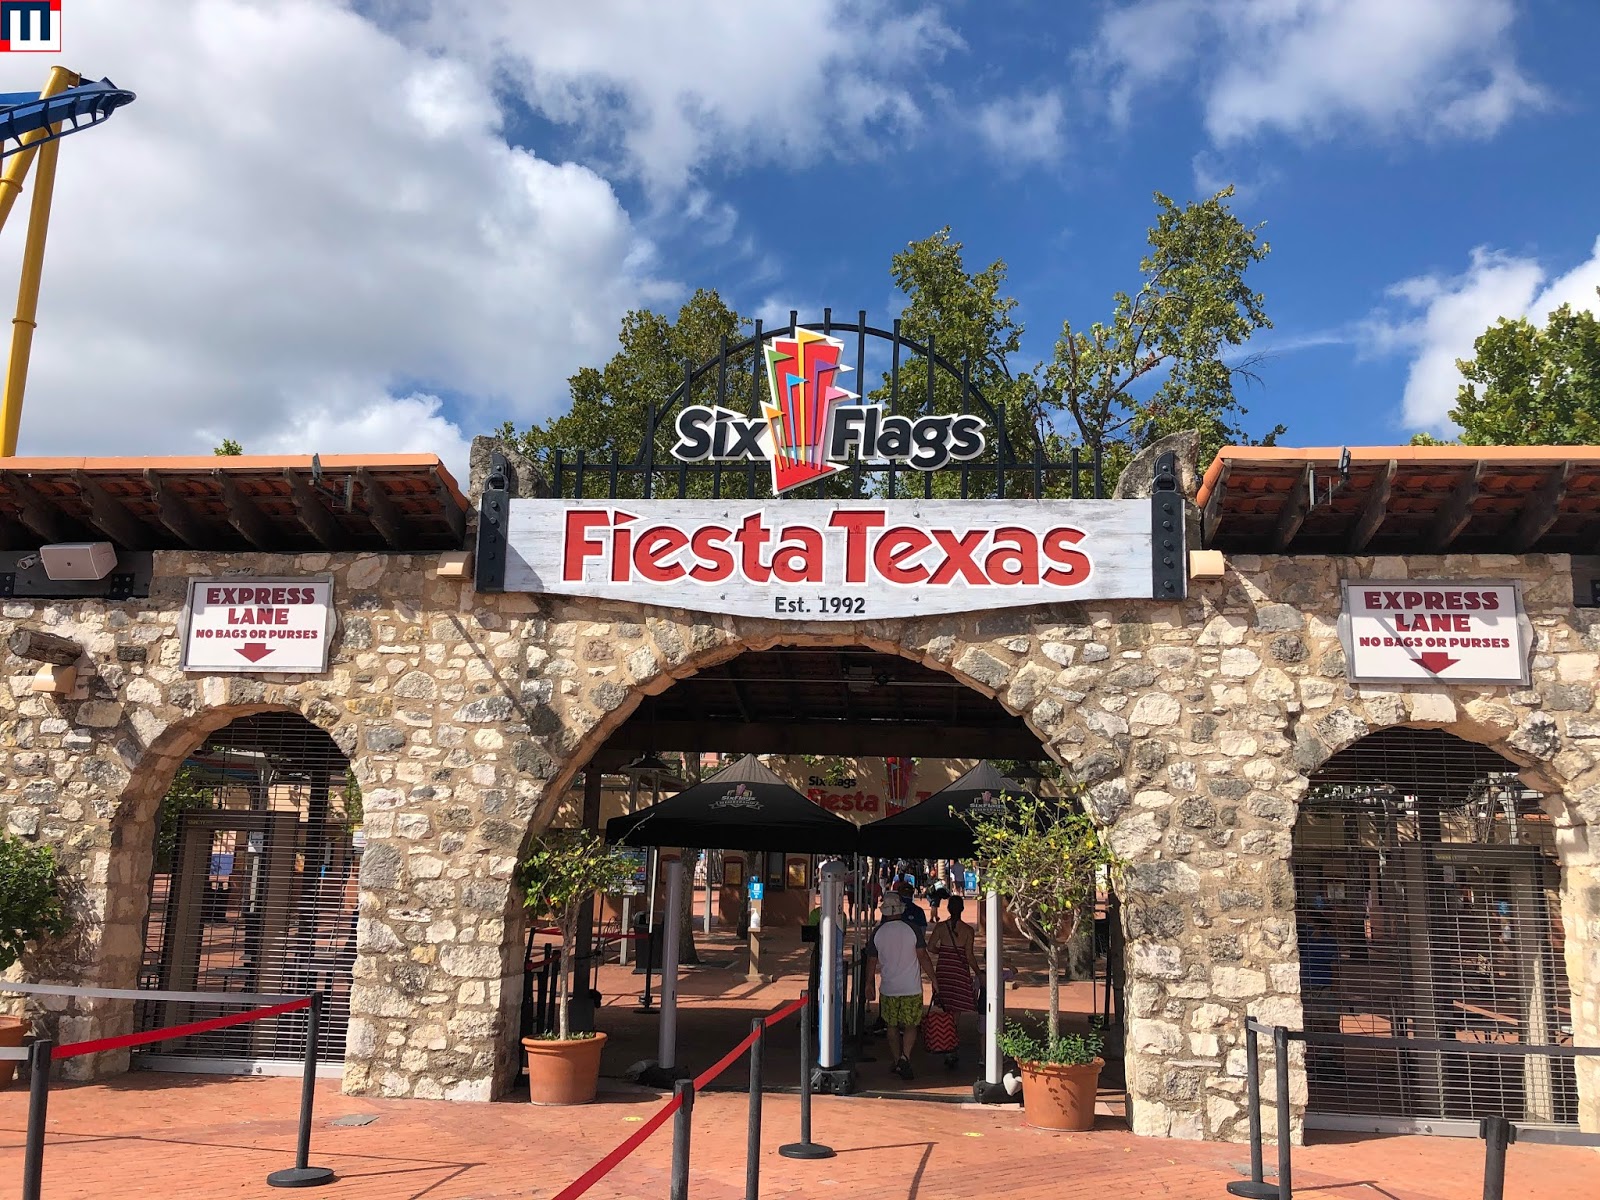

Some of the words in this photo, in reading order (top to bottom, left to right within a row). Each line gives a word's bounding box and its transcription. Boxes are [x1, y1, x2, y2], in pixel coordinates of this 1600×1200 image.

[673, 406, 770, 459] Six
[829, 406, 983, 470] Flags
[561, 509, 825, 583] Fiesta
[827, 509, 1093, 587] Texas
[206, 587, 316, 605] EXPRESS
[774, 596, 811, 613] Est.
[818, 596, 866, 614] 1992
[1363, 591, 1500, 611] EXPRESS
[227, 607, 290, 625] LANE
[1394, 613, 1472, 633] LANE
[195, 629, 214, 639] NO
[215, 629, 248, 639] BAGS
[249, 629, 267, 639] OR
[268, 629, 318, 639] PURSES
[1359, 636, 1381, 647] NO
[1383, 636, 1424, 648] BAGS
[1424, 637, 1448, 648] OR
[1449, 637, 1511, 648] PURSES
[808, 775, 826, 787] Six
